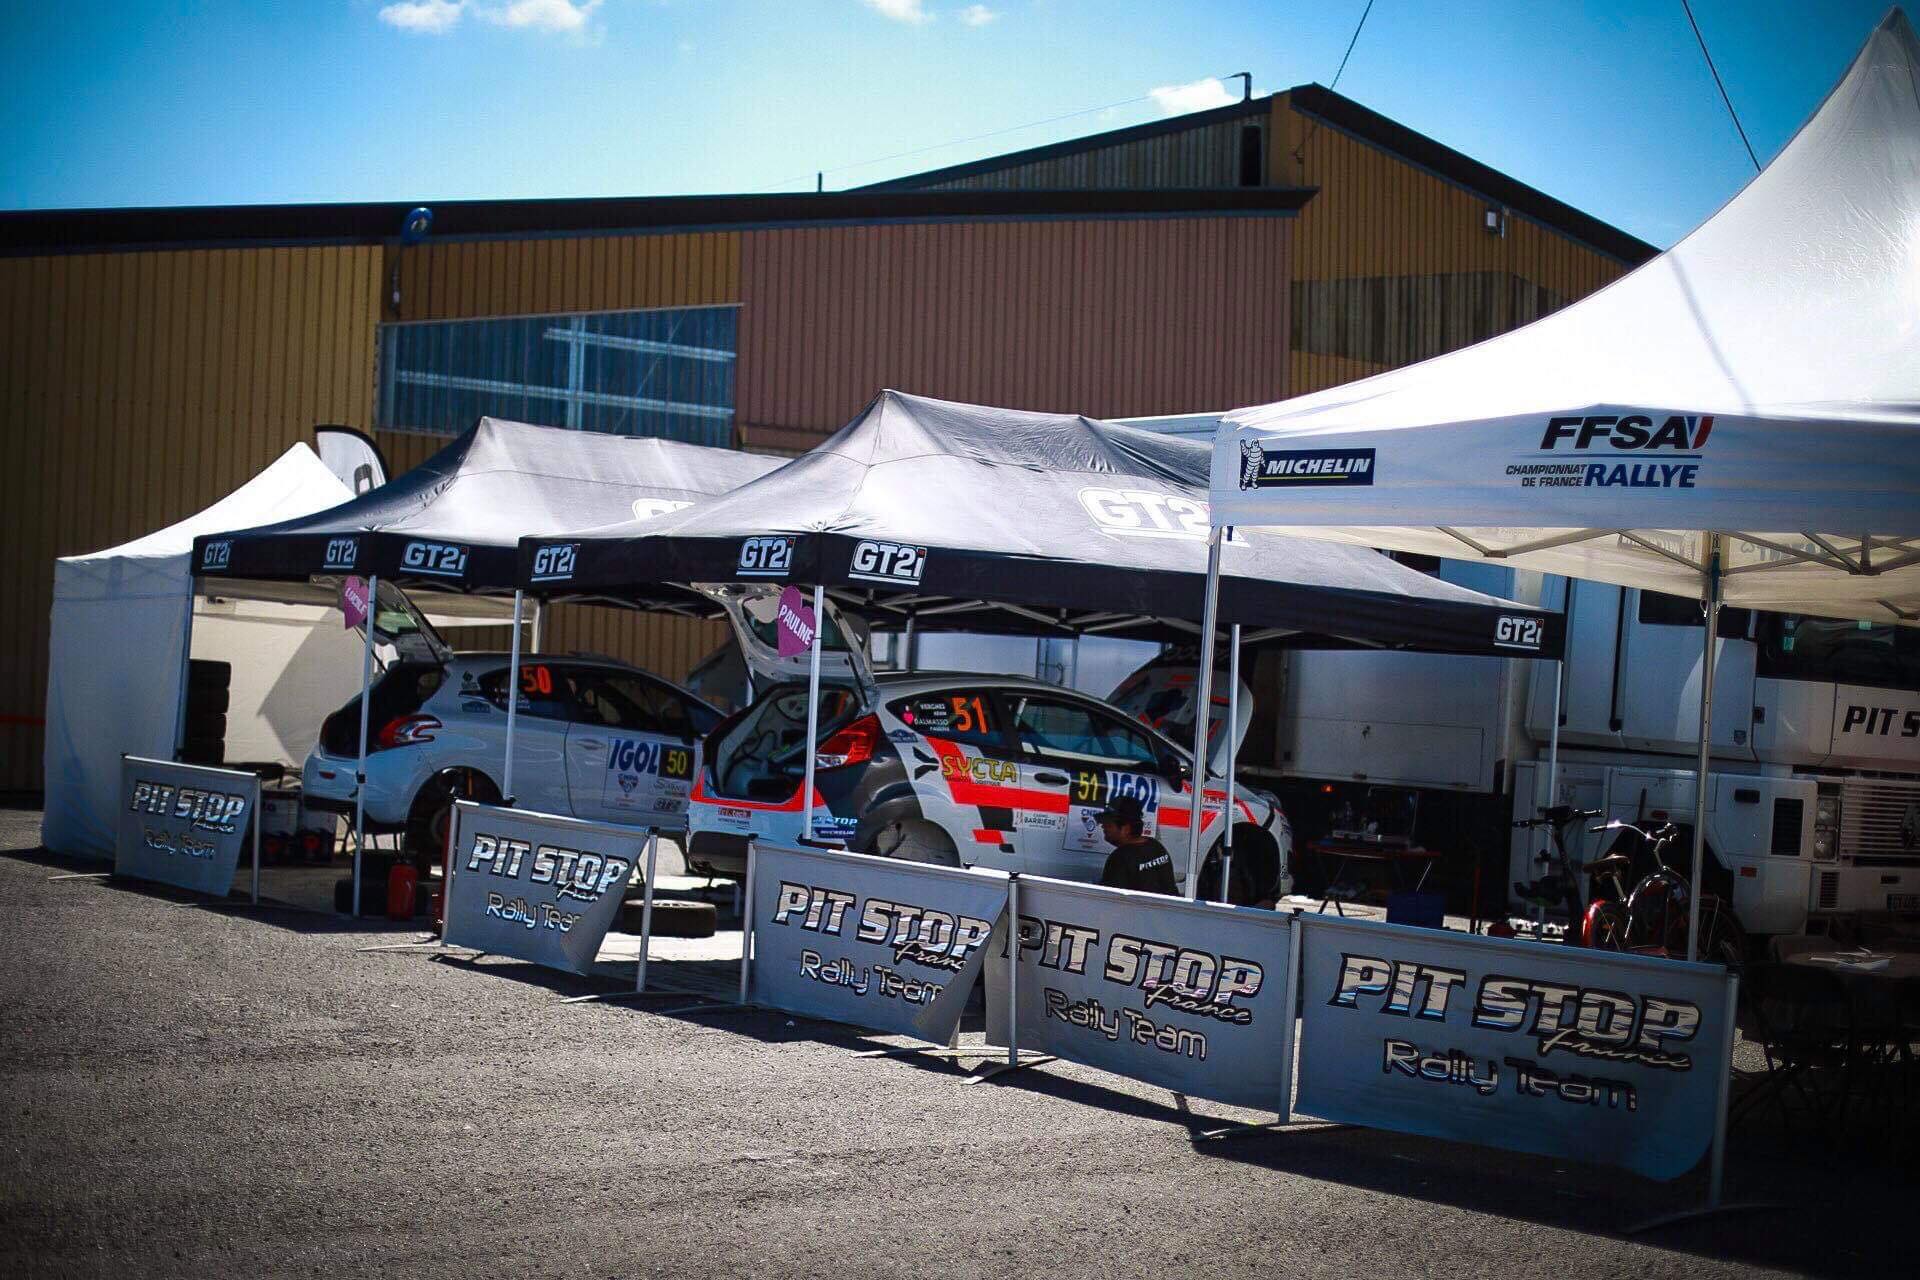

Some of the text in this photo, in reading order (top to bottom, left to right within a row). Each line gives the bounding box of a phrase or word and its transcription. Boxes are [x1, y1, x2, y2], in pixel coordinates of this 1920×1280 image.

[1540, 416, 1690, 449] FFSA
[1266, 457, 1371, 475] MICHELIN
[1505, 464, 1587, 475] CHAMPIONNAT
[1521, 476, 1584, 487] DE FRANCE
[1584, 463, 1699, 488] RALLYE
[1084, 489, 1210, 532] GT2
[203, 541, 232, 565] GT2i
[325, 540, 358, 564] GT2i
[403, 543, 468, 570] GT2i
[534, 546, 578, 574] GT2i
[740, 539, 793, 568] GT2i
[853, 542, 924, 577] GT2i
[778, 604, 813, 645] PAULINE
[1496, 616, 1544, 644] GT2i
[519, 664, 553, 695] 50
[951, 695, 989, 736] 51
[1842, 705, 1898, 735] PIT
[609, 739, 659, 774] IGOL
[665, 750, 688, 775] 50
[131, 780, 245, 823] PIT STOP
[1078, 771, 1098, 801] 51
[143, 826, 216, 860] Rally Team
[467, 832, 629, 894] PIT STOP
[486, 892, 538, 929] Rally
[771, 880, 993, 958] PIT STOP
[799, 948, 869, 996] Rally
[1000, 911, 1264, 1005] PIT STOP
[1145, 983, 1253, 1025] France
[1326, 952, 1702, 1051] PIT STOP
[1043, 987, 1208, 1061] Rally Team
[1537, 1027, 1693, 1073] France
[1382, 1037, 1638, 1113] Rally Team
